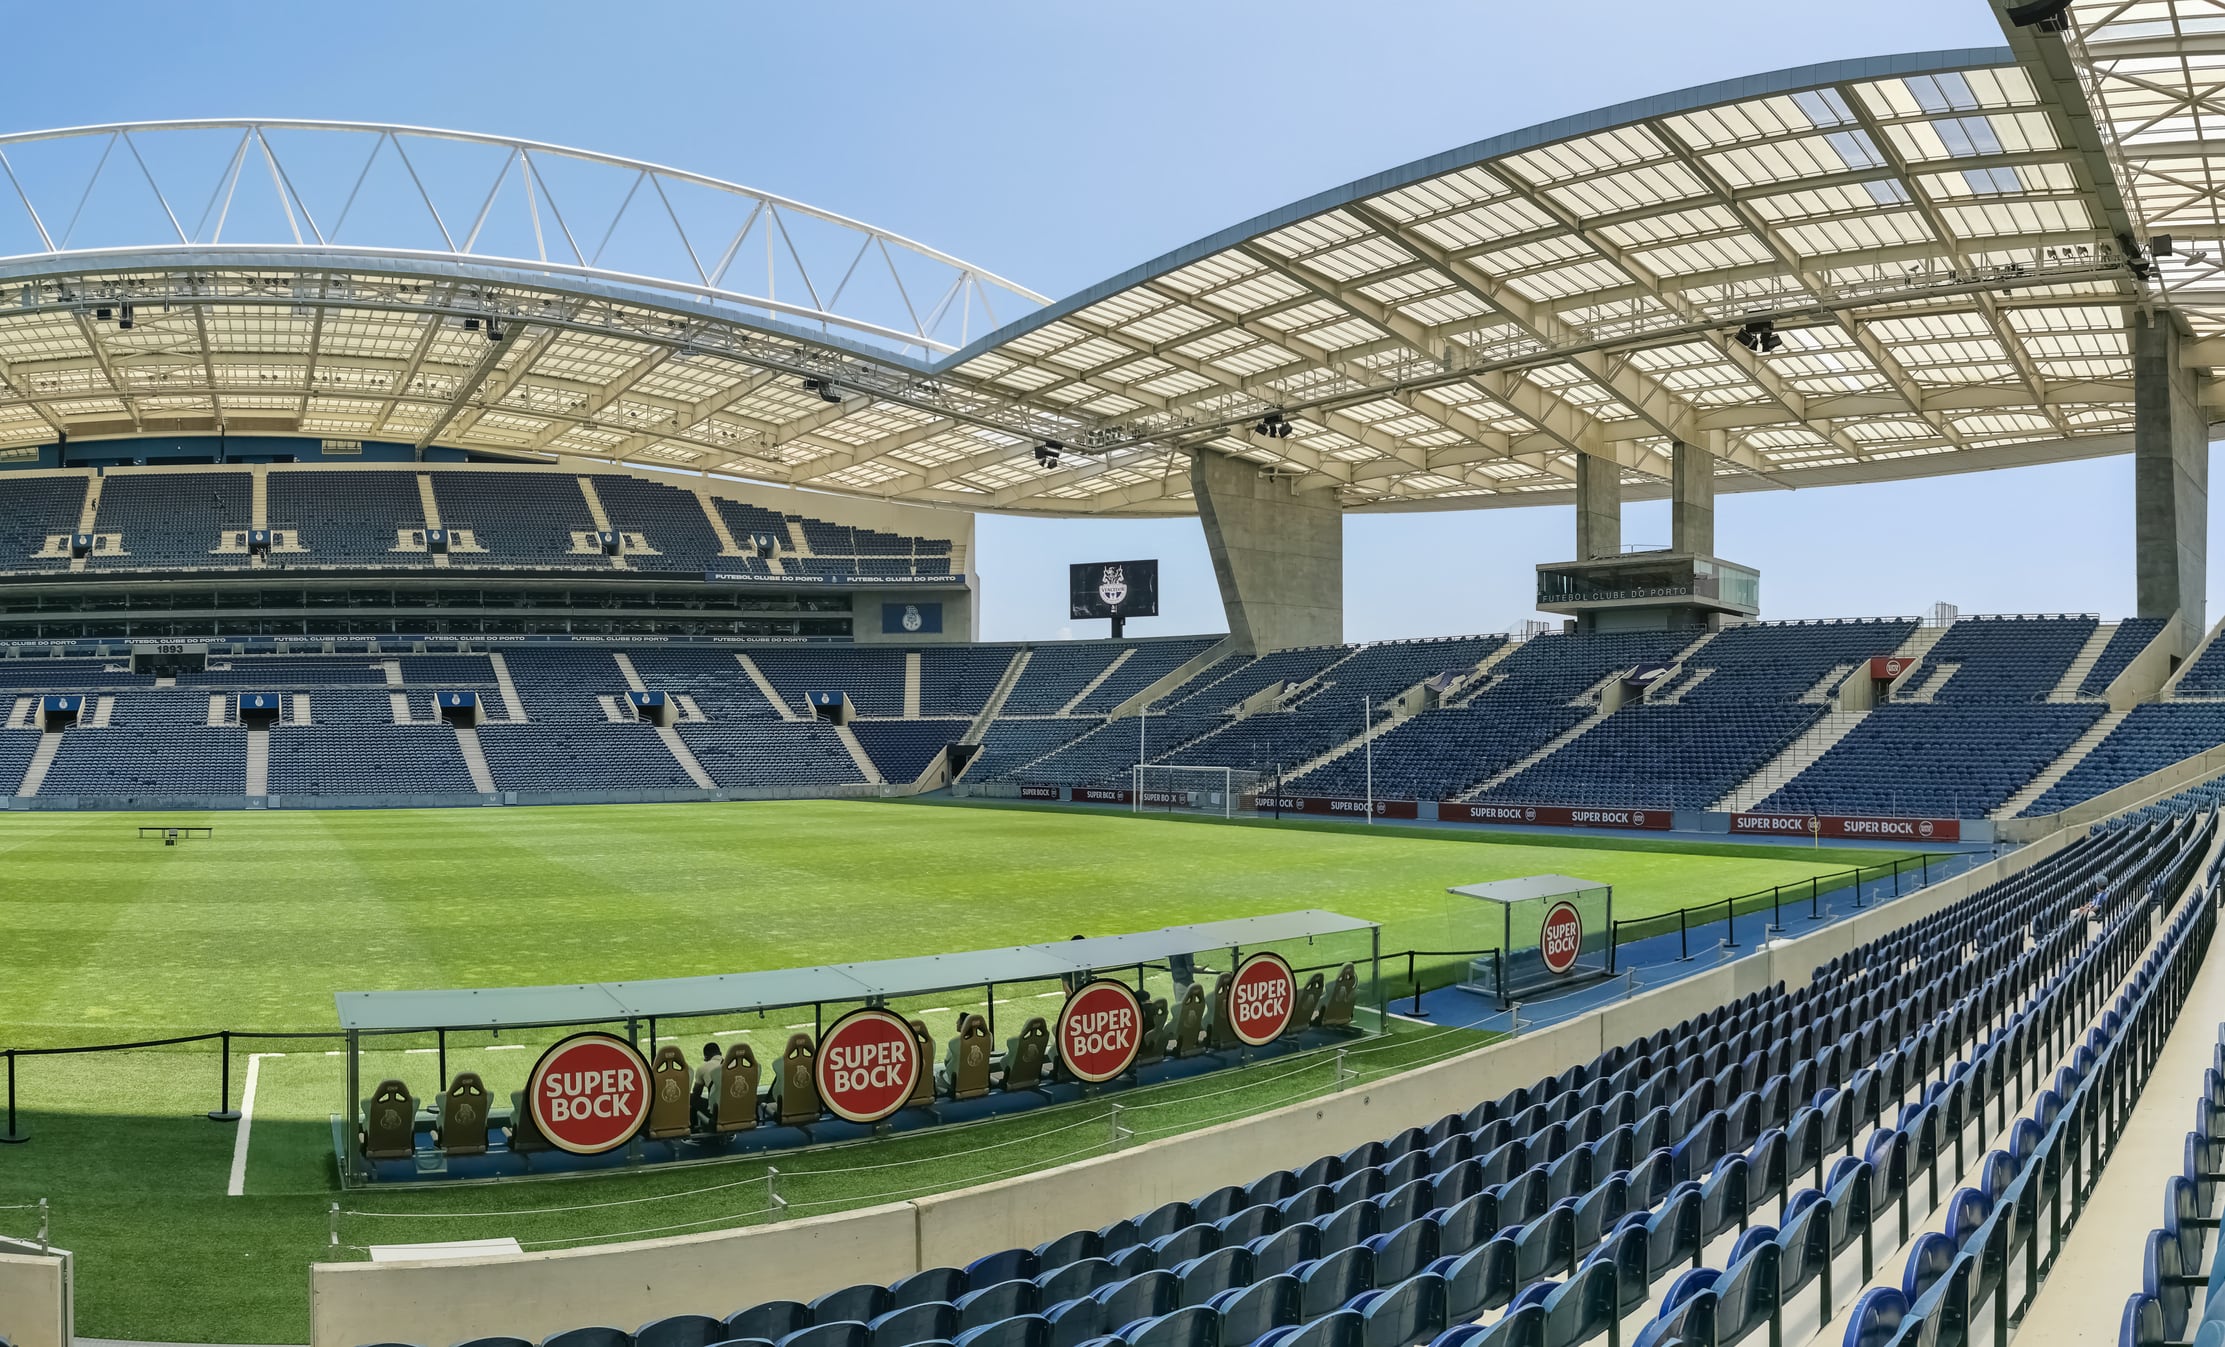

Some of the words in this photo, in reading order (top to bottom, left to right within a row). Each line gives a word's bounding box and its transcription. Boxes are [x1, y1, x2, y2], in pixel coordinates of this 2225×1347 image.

[1542, 593, 1588, 602] FUTEBOL
[1592, 592, 1625, 600] CLUBE
[1632, 590, 1644, 598] DO
[1650, 587, 1686, 596] PORTO
[157, 645, 183, 654] 1893
[1255, 798, 1275, 806] SUPER
[1275, 799, 1293, 808] OCK
[1331, 801, 1352, 811] SUPER
[1471, 807, 1496, 817] SUPER
[1497, 808, 1521, 819] BOCK
[1572, 811, 1600, 822] SUPER
[1602, 812, 1628, 823] BOCK
[1738, 817, 1770, 829] SUPER
[1772, 818, 1802, 830] BOCK
[1844, 820, 1879, 832] SUPER
[1882, 822, 1913, 834] BOCK
[1547, 922, 1576, 941] SUPER
[1548, 936, 1575, 955] BOCK
[1237, 978, 1286, 1004] SUPER
[1239, 998, 1284, 1022] BOCK
[1070, 1008, 1132, 1037] SUPER
[1073, 1029, 1130, 1057] BOCK
[829, 1040, 906, 1071] SUPER
[546, 1068, 635, 1098] SUPER
[834, 1064, 903, 1093] BOCK
[551, 1093, 633, 1122] BOCK
